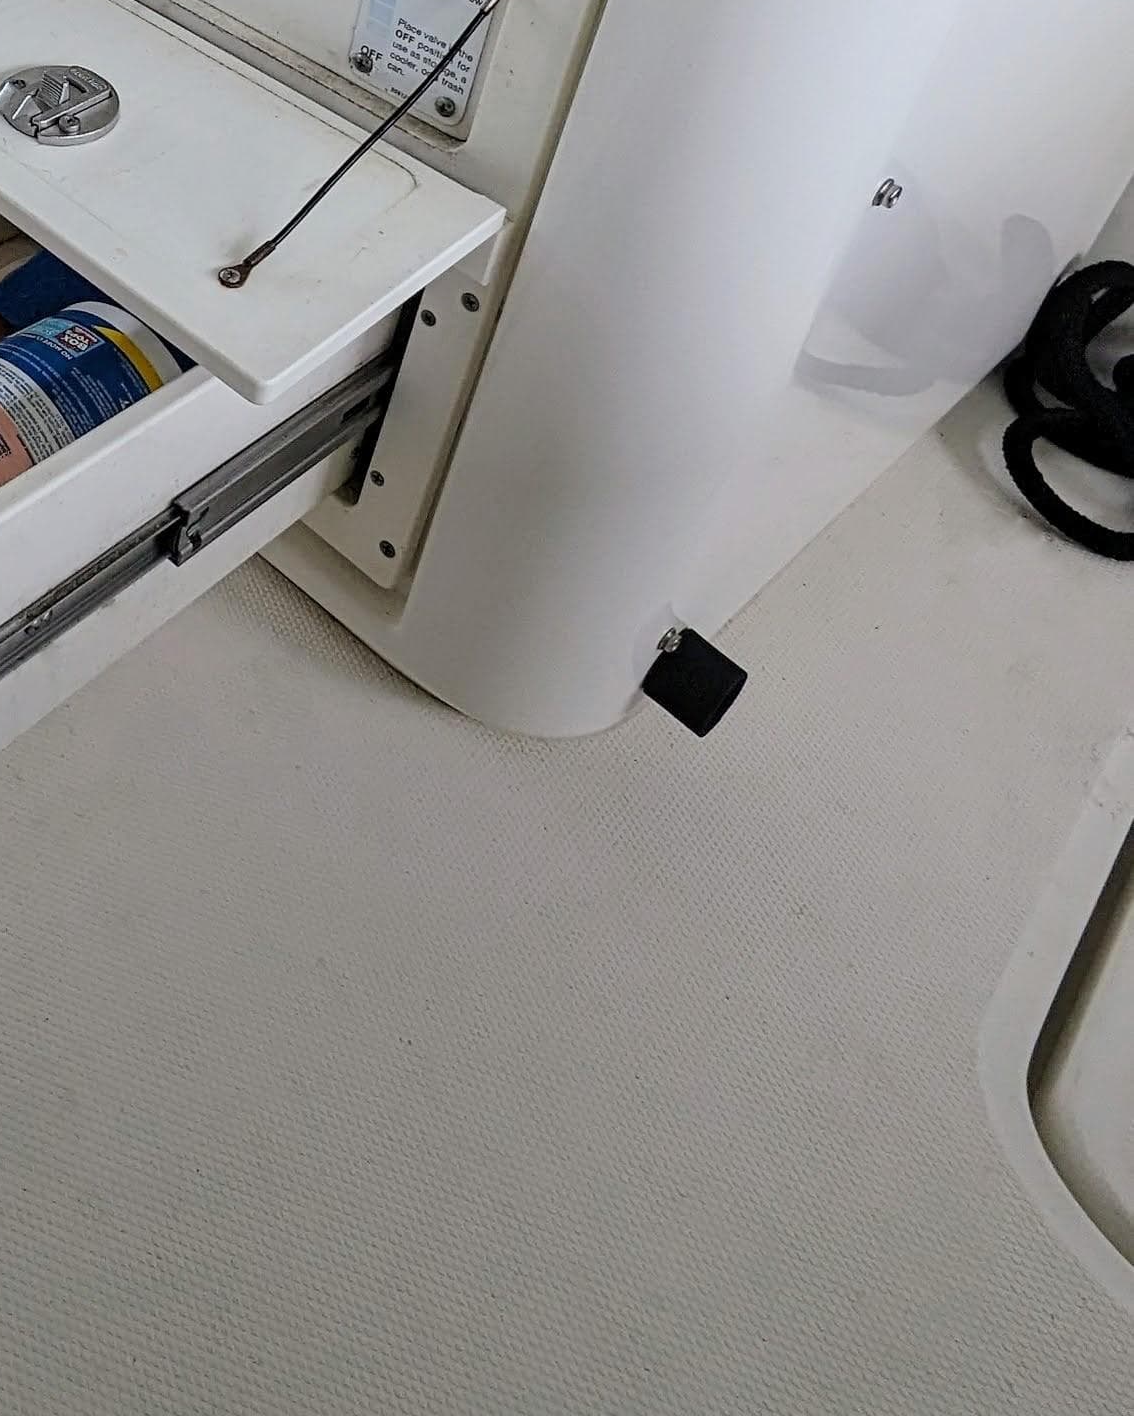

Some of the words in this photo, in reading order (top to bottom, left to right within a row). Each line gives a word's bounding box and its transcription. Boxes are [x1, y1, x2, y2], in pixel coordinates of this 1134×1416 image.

[397, 17, 422, 36] Place
[424, 32, 447, 49] valve
[360, 45, 383, 61] OFF
[395, 29, 415, 44] OFF
[457, 60, 470, 72] for
[392, 41, 408, 53] use
[410, 50, 421, 60] as
[460, 76, 467, 84] a
[441, 77, 464, 95] trash
[61, 334, 88, 351] BOX
[60, 350, 73, 360] NO
